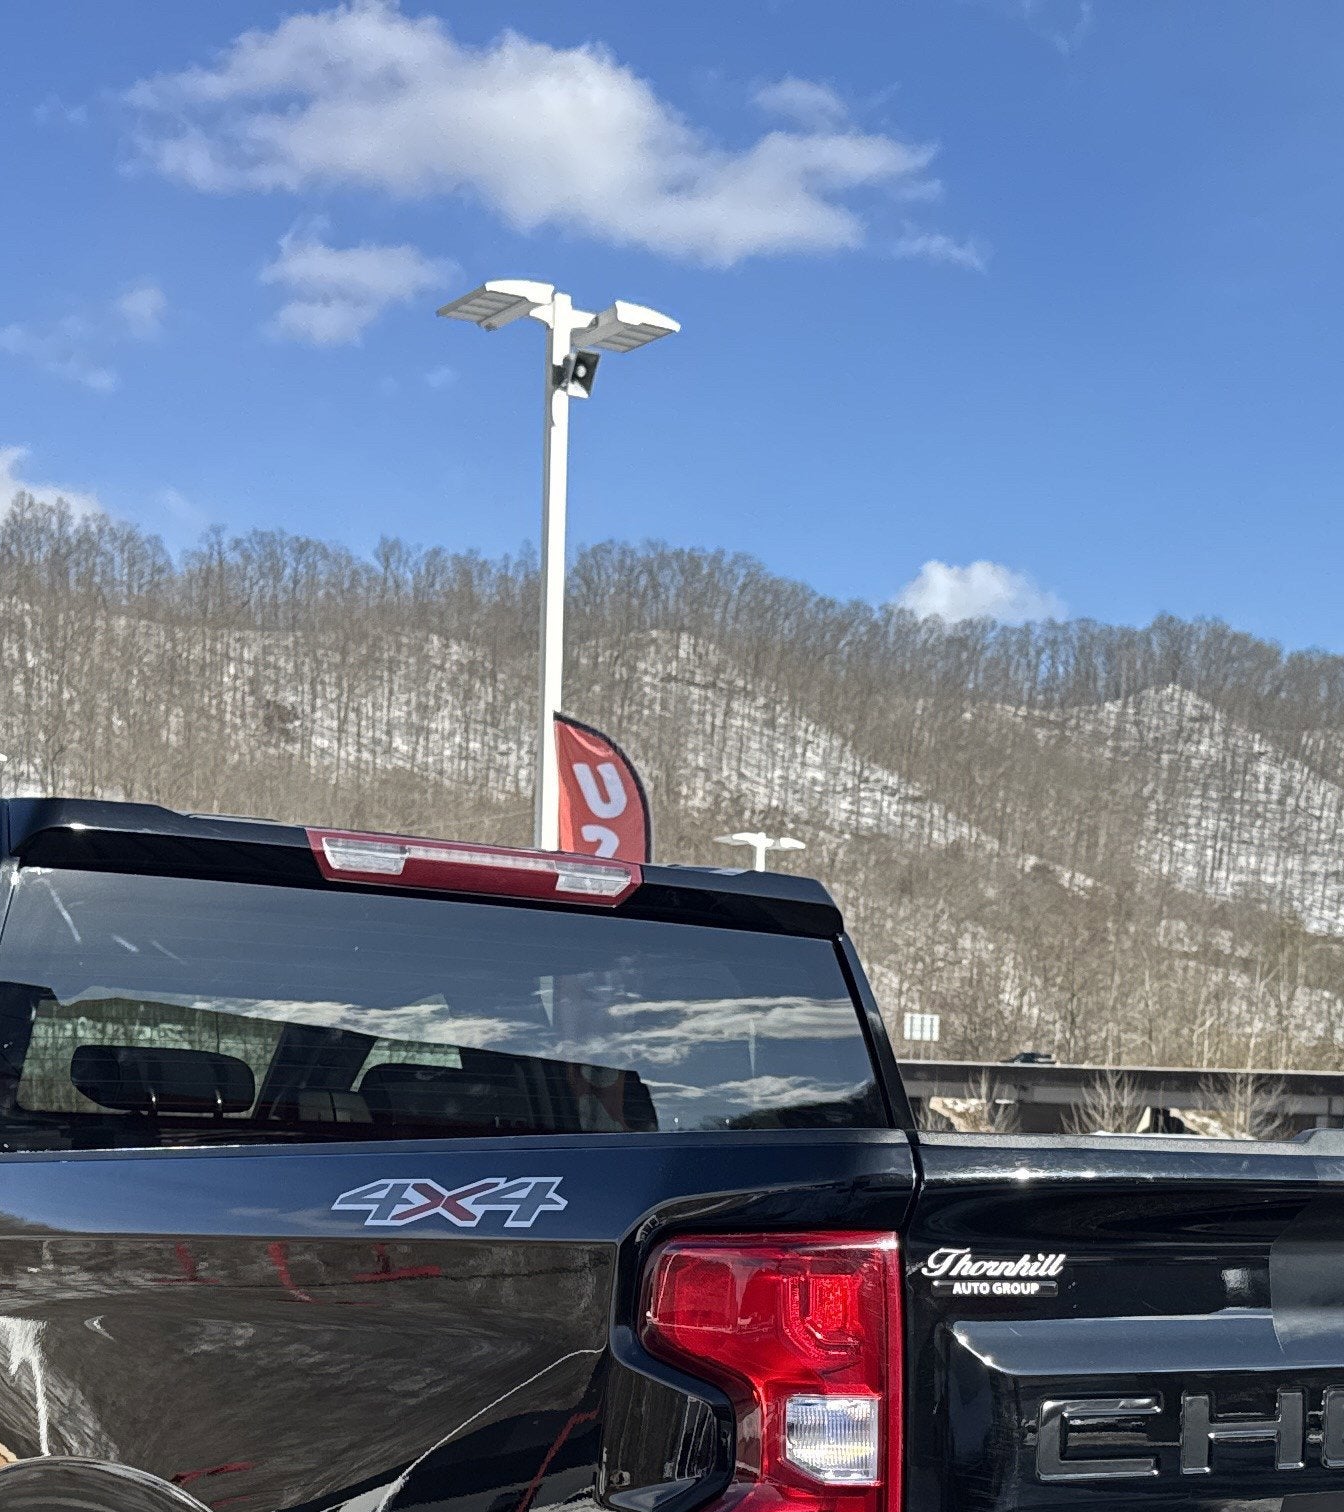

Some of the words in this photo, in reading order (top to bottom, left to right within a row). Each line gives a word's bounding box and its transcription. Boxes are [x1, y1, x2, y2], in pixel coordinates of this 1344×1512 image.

[921, 1247, 1067, 1277] Thornhill
[952, 1282, 991, 1295] AUTO
[992, 1282, 1040, 1295] GROUP
